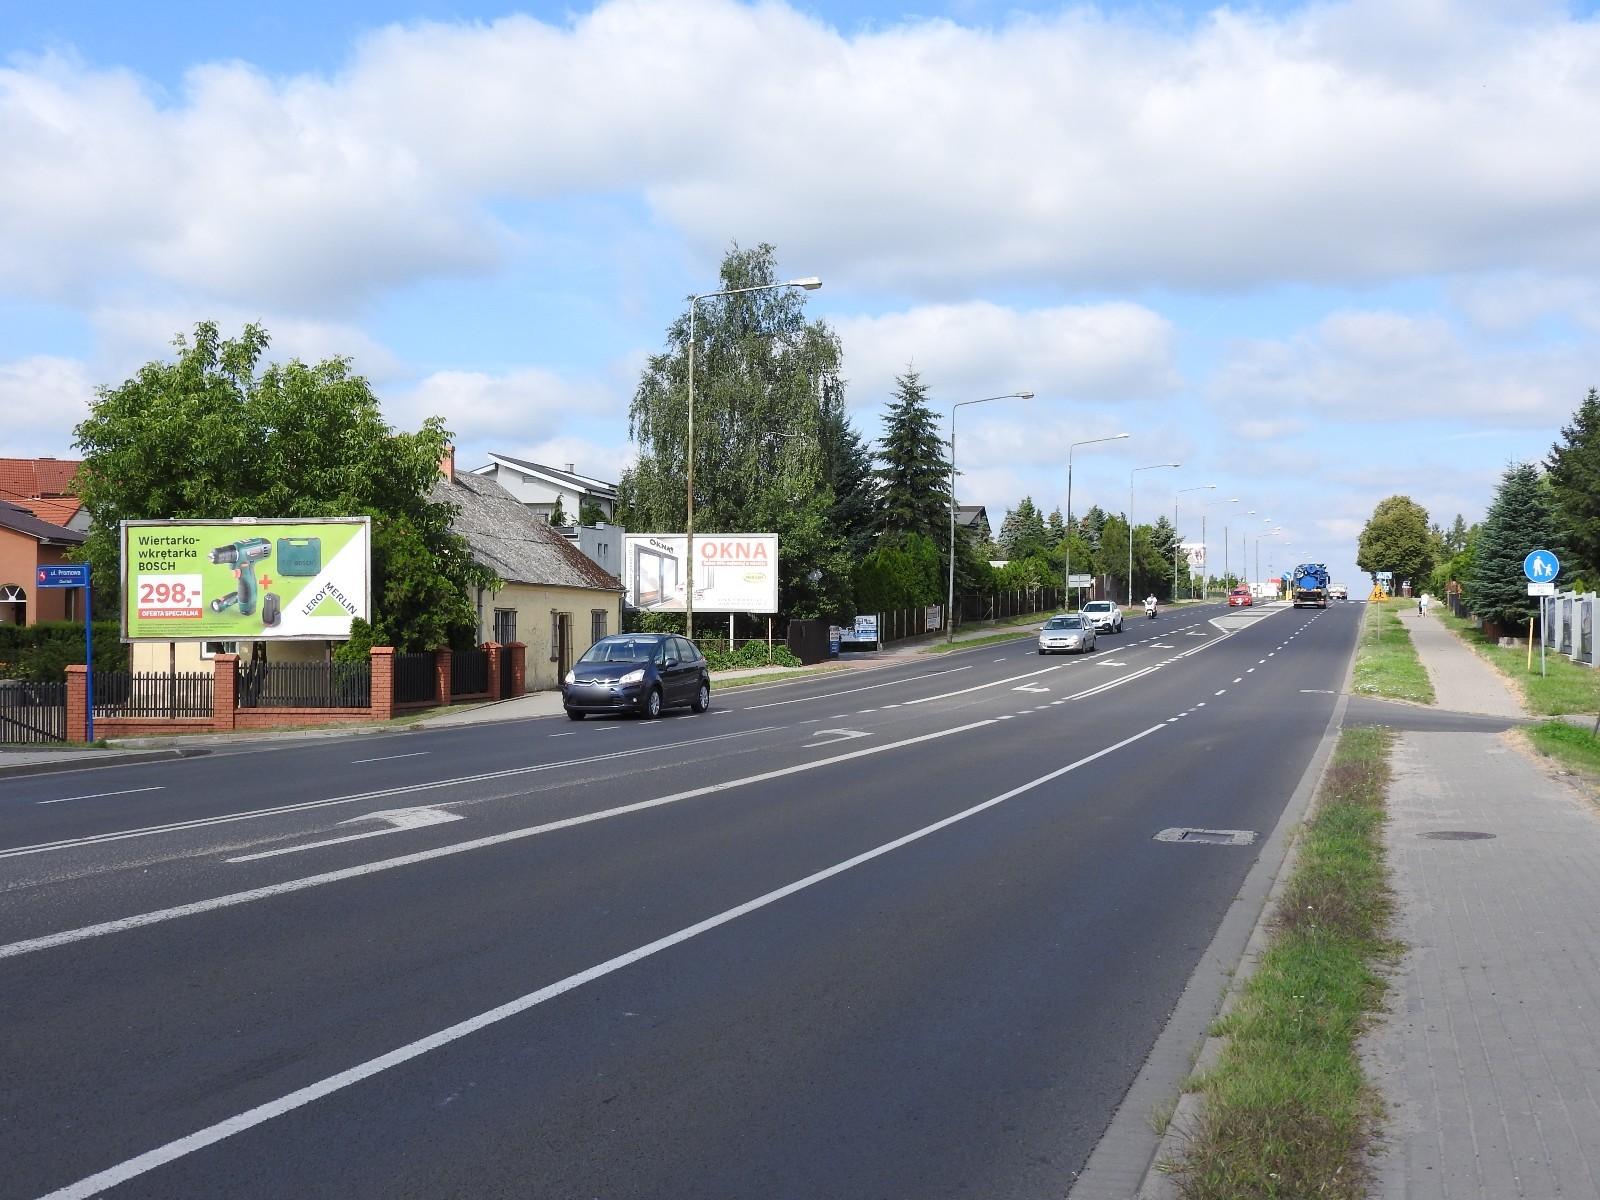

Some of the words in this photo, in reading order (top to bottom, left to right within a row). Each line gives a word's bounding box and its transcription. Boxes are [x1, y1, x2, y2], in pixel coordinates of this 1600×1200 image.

[138, 535, 200, 545] Wiertarko-
[138, 548, 198, 559] wkrętarka
[701, 542, 767, 559] OKNA
[138, 562, 176, 571] BOSCH
[302, 587, 327, 616] LEROY
[325, 582, 358, 615] MERLIN
